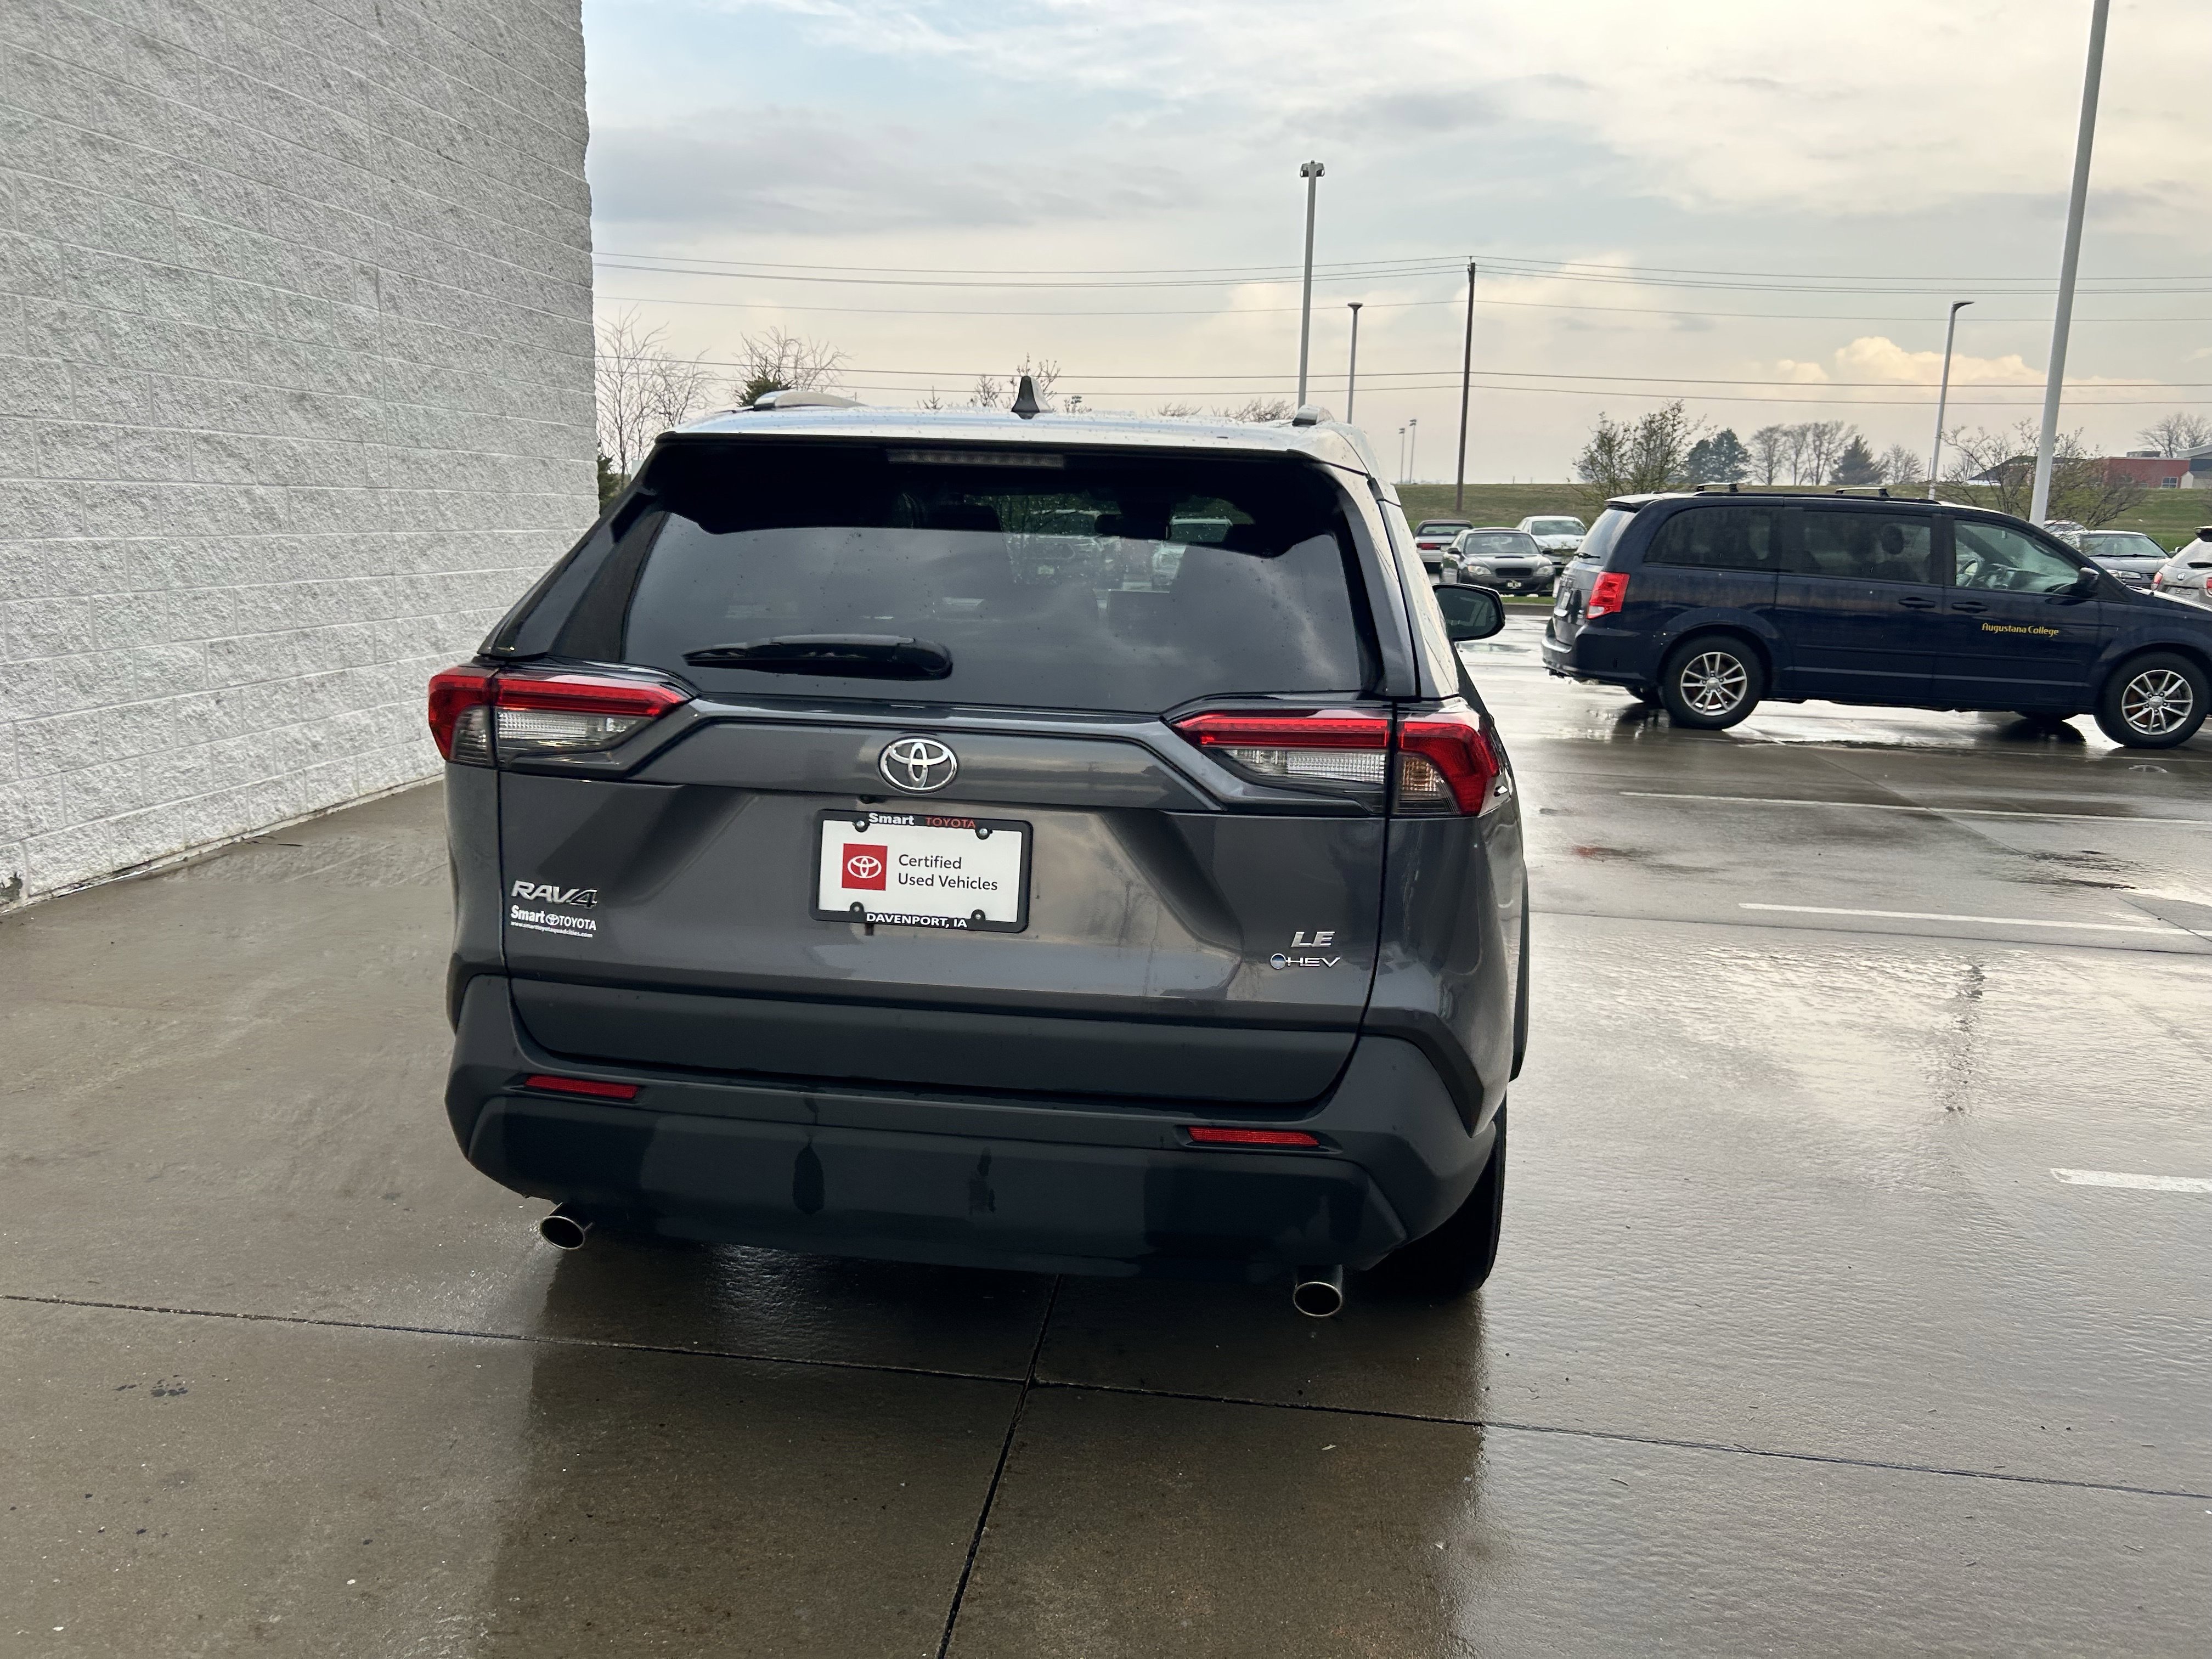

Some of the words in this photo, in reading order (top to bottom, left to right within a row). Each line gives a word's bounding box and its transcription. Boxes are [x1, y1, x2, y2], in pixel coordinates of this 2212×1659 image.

[1982, 623, 2027, 634] Augustana
[2028, 625, 2059, 637] College
[868, 812, 915, 826] Smart
[924, 816, 977, 828] TOYOTA
[899, 854, 962, 870] Certified
[898, 873, 934, 887] Used
[939, 874, 998, 890] Vehicles
[511, 880, 598, 909] RAV4
[511, 905, 545, 923] Smart
[558, 916, 596, 930] TOYOTA
[866, 913, 950, 928] DAVENPORT,
[954, 918, 967, 928] IA
[1291, 931, 1335, 947] LE
[1287, 956, 1340, 967] HEV
